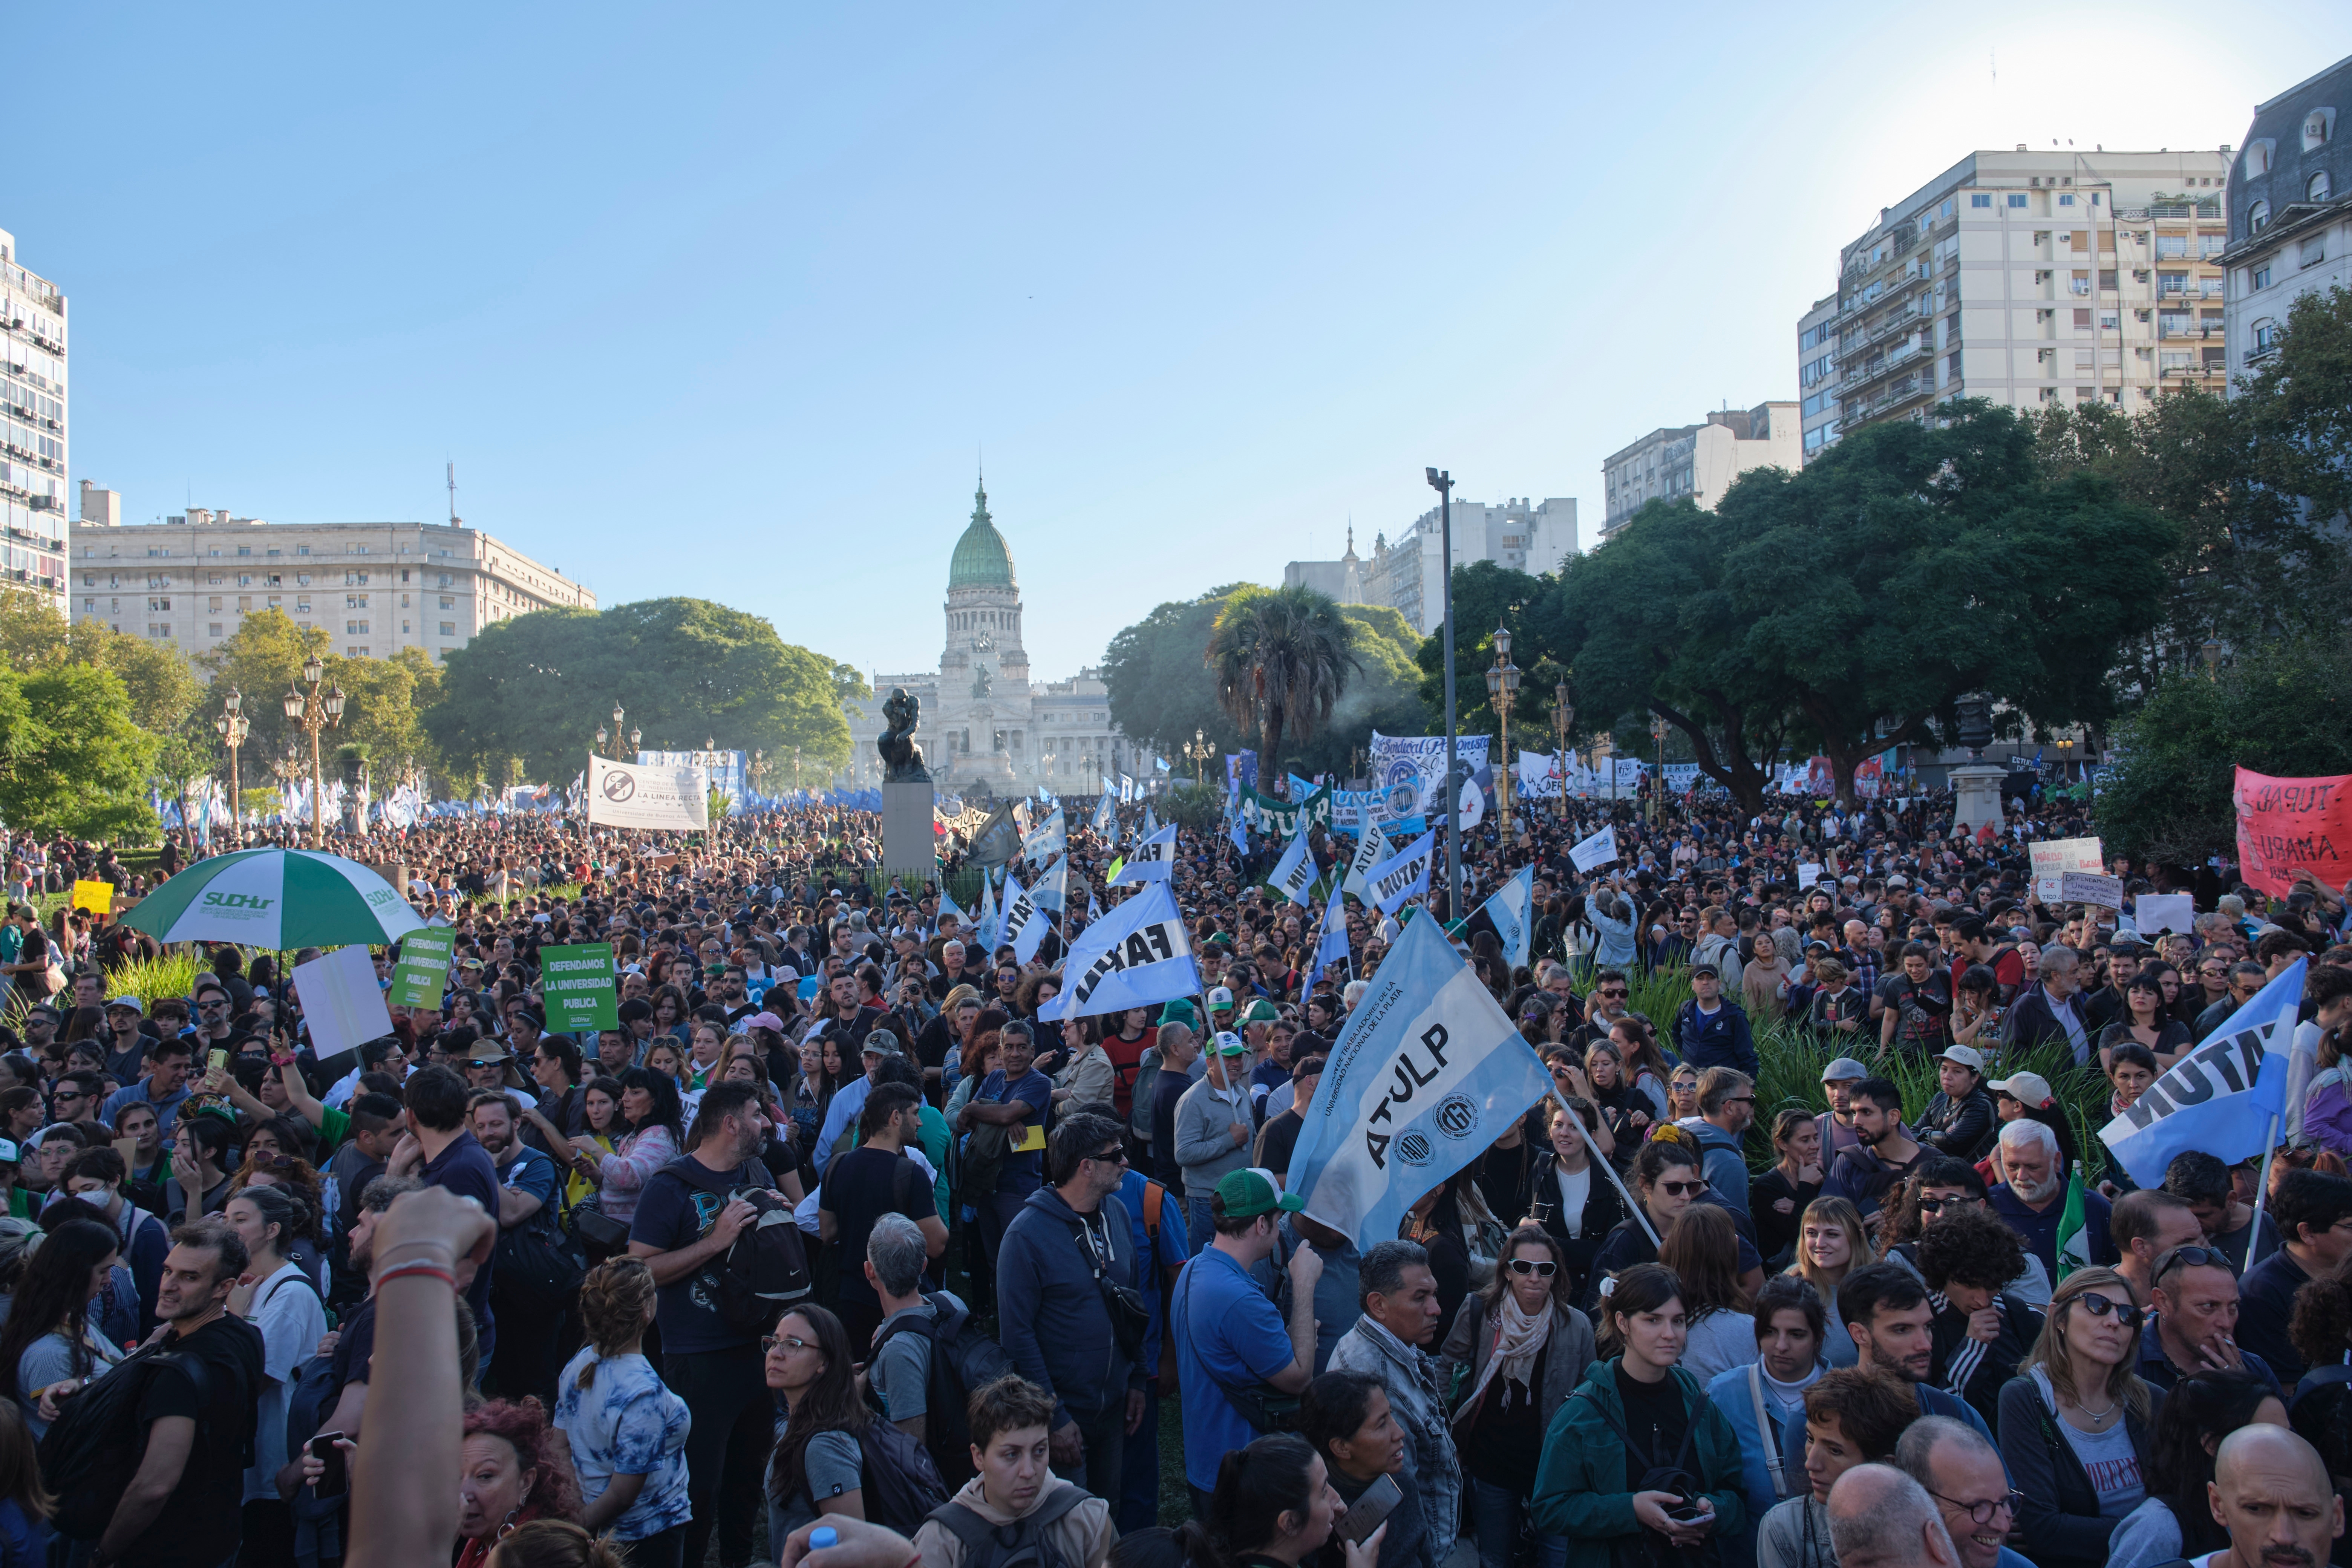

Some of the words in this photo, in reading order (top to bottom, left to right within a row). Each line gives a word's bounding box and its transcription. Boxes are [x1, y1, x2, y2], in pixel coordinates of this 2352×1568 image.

[1427, 735, 1490, 755] Peonista
[1355, 827, 1381, 875] ATULP
[2066, 861, 2078, 869] AL
[2066, 874, 2110, 886] DEFENDAMOS
[202, 892, 275, 909] SUDHur
[407, 937, 447, 951] DEFENDAMOS
[400, 954, 407, 964] LA
[408, 956, 447, 970] UNIVERSIDAD
[550, 958, 605, 972] DEFENDAMOS
[406, 973, 431, 986] PUBLICA
[545, 981, 557, 991] LA
[558, 977, 612, 990] UNIVERSIDAD
[564, 997, 598, 1009] PUBLICA
[1336, 1056, 1344, 1067] DE
[1341, 1001, 1380, 1057] TRABAJADORES
[1378, 992, 1388, 1002] DE
[1386, 981, 1396, 991] LA
[1325, 1068, 1347, 1116] UNIVERSIDAD
[1344, 1031, 1370, 1070] NACIONAL
[1367, 1019, 1378, 1032] DE
[1376, 1010, 1386, 1020] LA
[1383, 988, 1403, 1011] PLATA
[1367, 1023, 1448, 1170] ATULP
[1439, 1096, 1456, 1107] GENERAL
[1465, 1098, 1478, 1113] TRABAJO
[1442, 1102, 1472, 1131] CGT
[1401, 1134, 1430, 1160] FATUN
